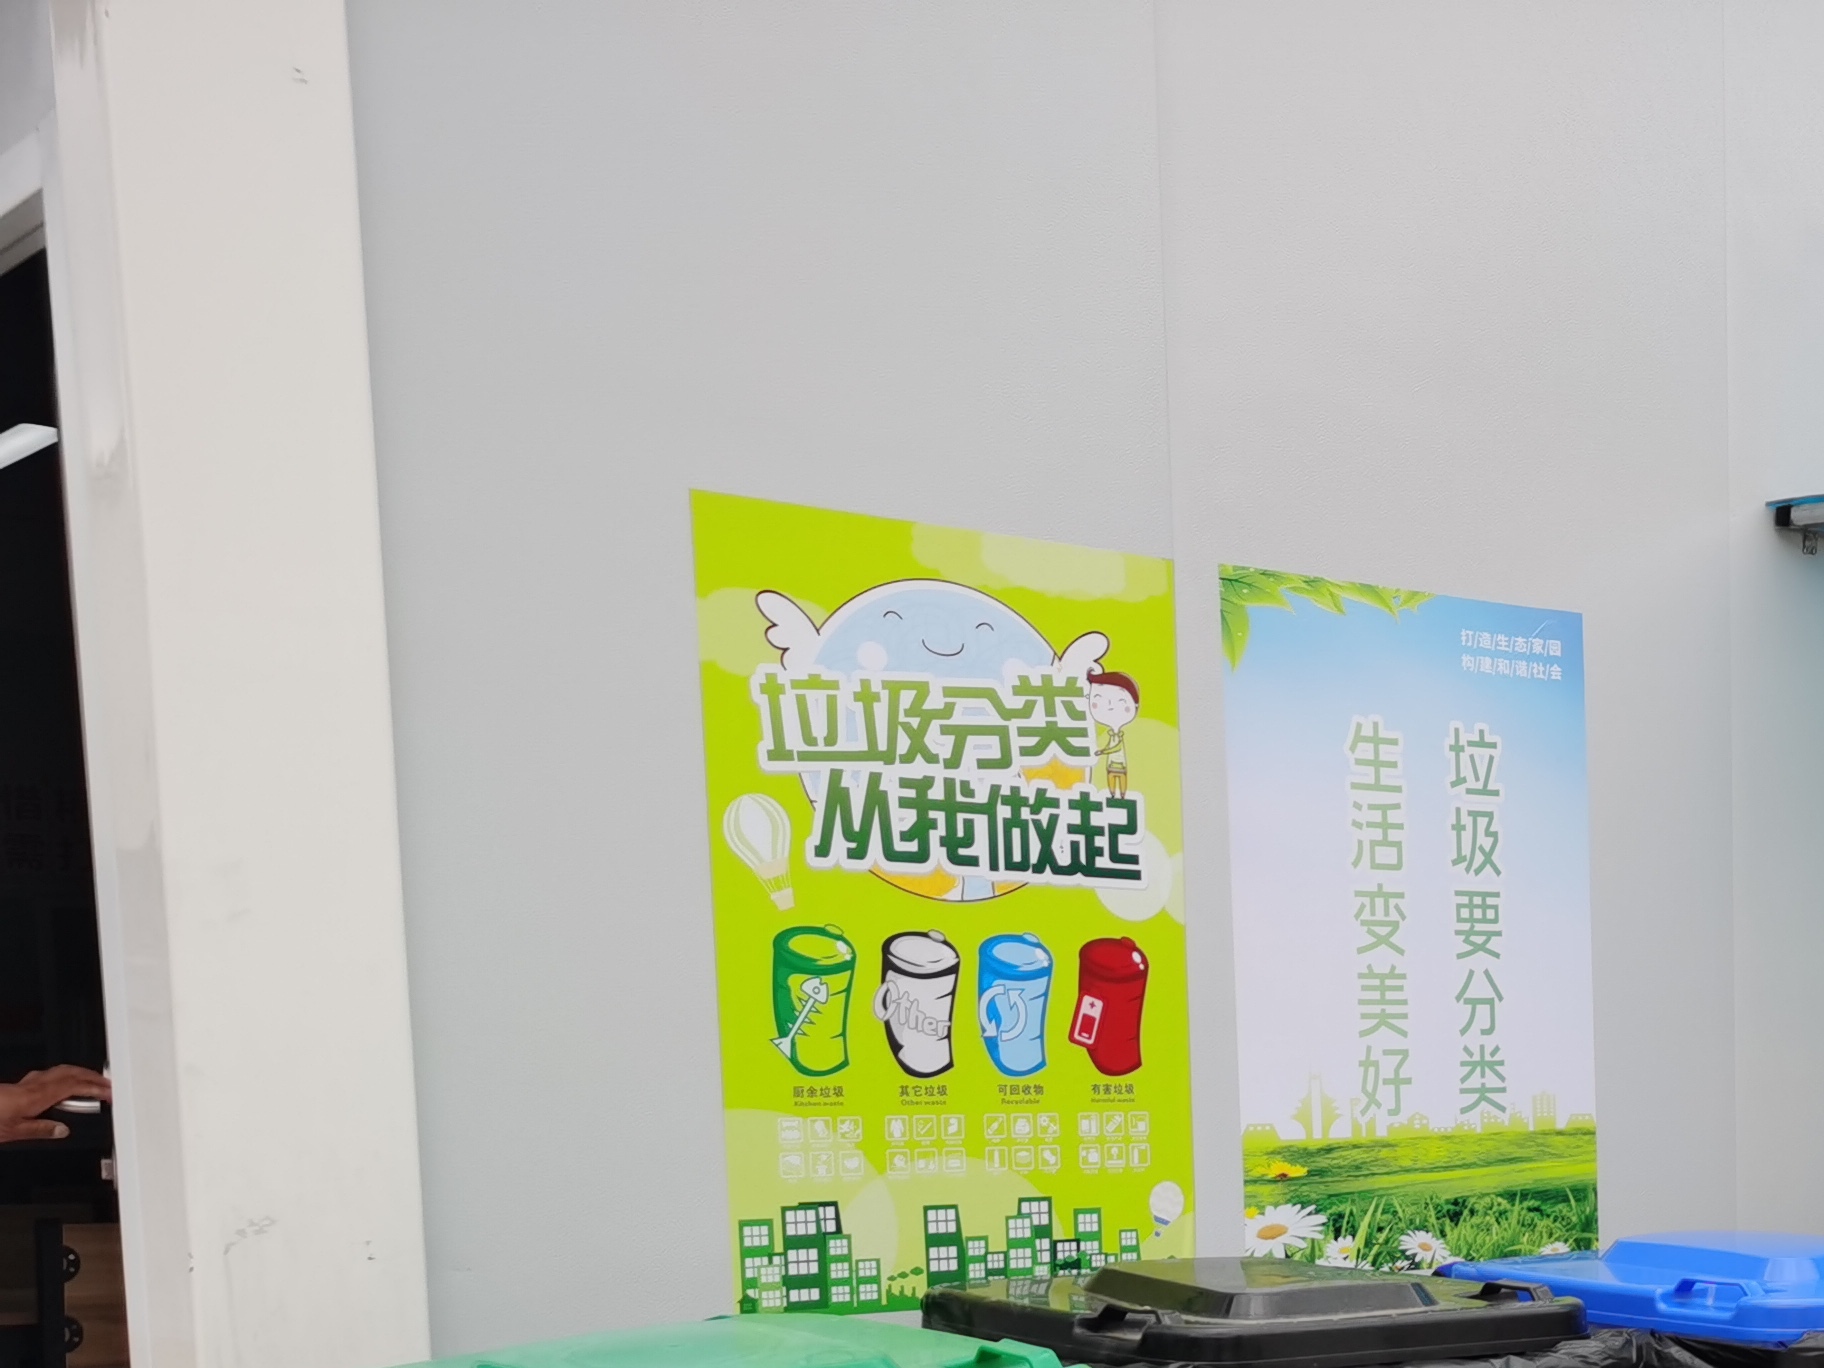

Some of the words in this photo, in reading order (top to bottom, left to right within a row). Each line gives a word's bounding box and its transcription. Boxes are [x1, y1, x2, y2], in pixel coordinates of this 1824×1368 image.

[759, 672, 1091, 771] 垃圾分类
[814, 768, 1143, 881] 从我做起
[1348, 719, 1412, 1117] 生活变美好
[1448, 725, 1507, 1115] 垃圾要分类
[873, 980, 951, 1037] Other
[793, 1085, 844, 1098] 厨余垃圾
[899, 1084, 948, 1097] 其它垃圾
[997, 1083, 1044, 1096] 可回收物
[1091, 1083, 1135, 1095] 有害垃圾
